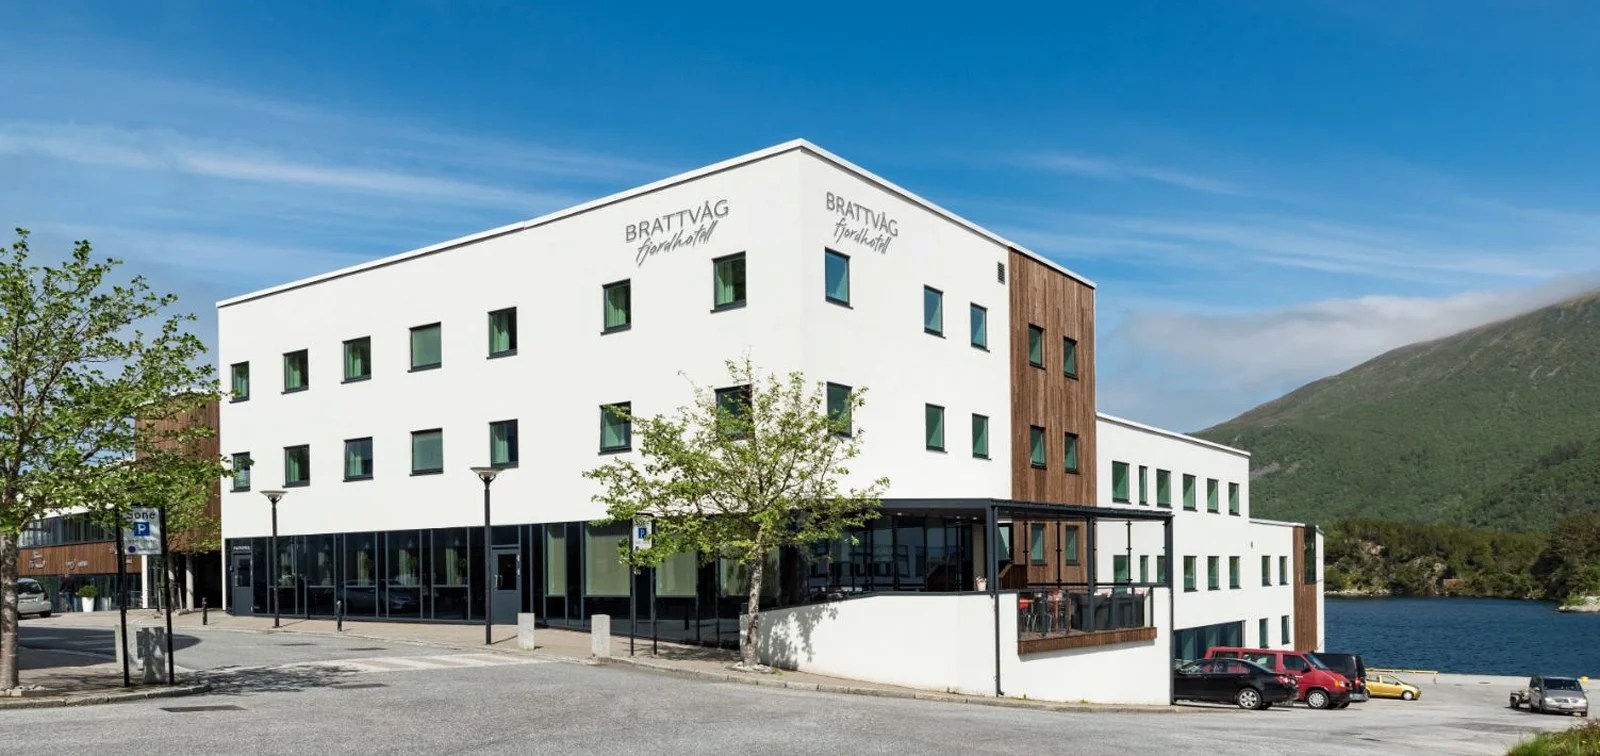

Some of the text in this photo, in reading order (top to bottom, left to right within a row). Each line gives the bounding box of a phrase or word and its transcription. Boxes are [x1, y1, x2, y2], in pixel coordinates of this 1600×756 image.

[625, 199, 729, 243] BRATTVÅG
[826, 191, 898, 237] BRATTVÅG
[833, 217, 892, 254] fjordhotell
[635, 219, 719, 268] fjordhotell
[137, 523, 147, 535] P
